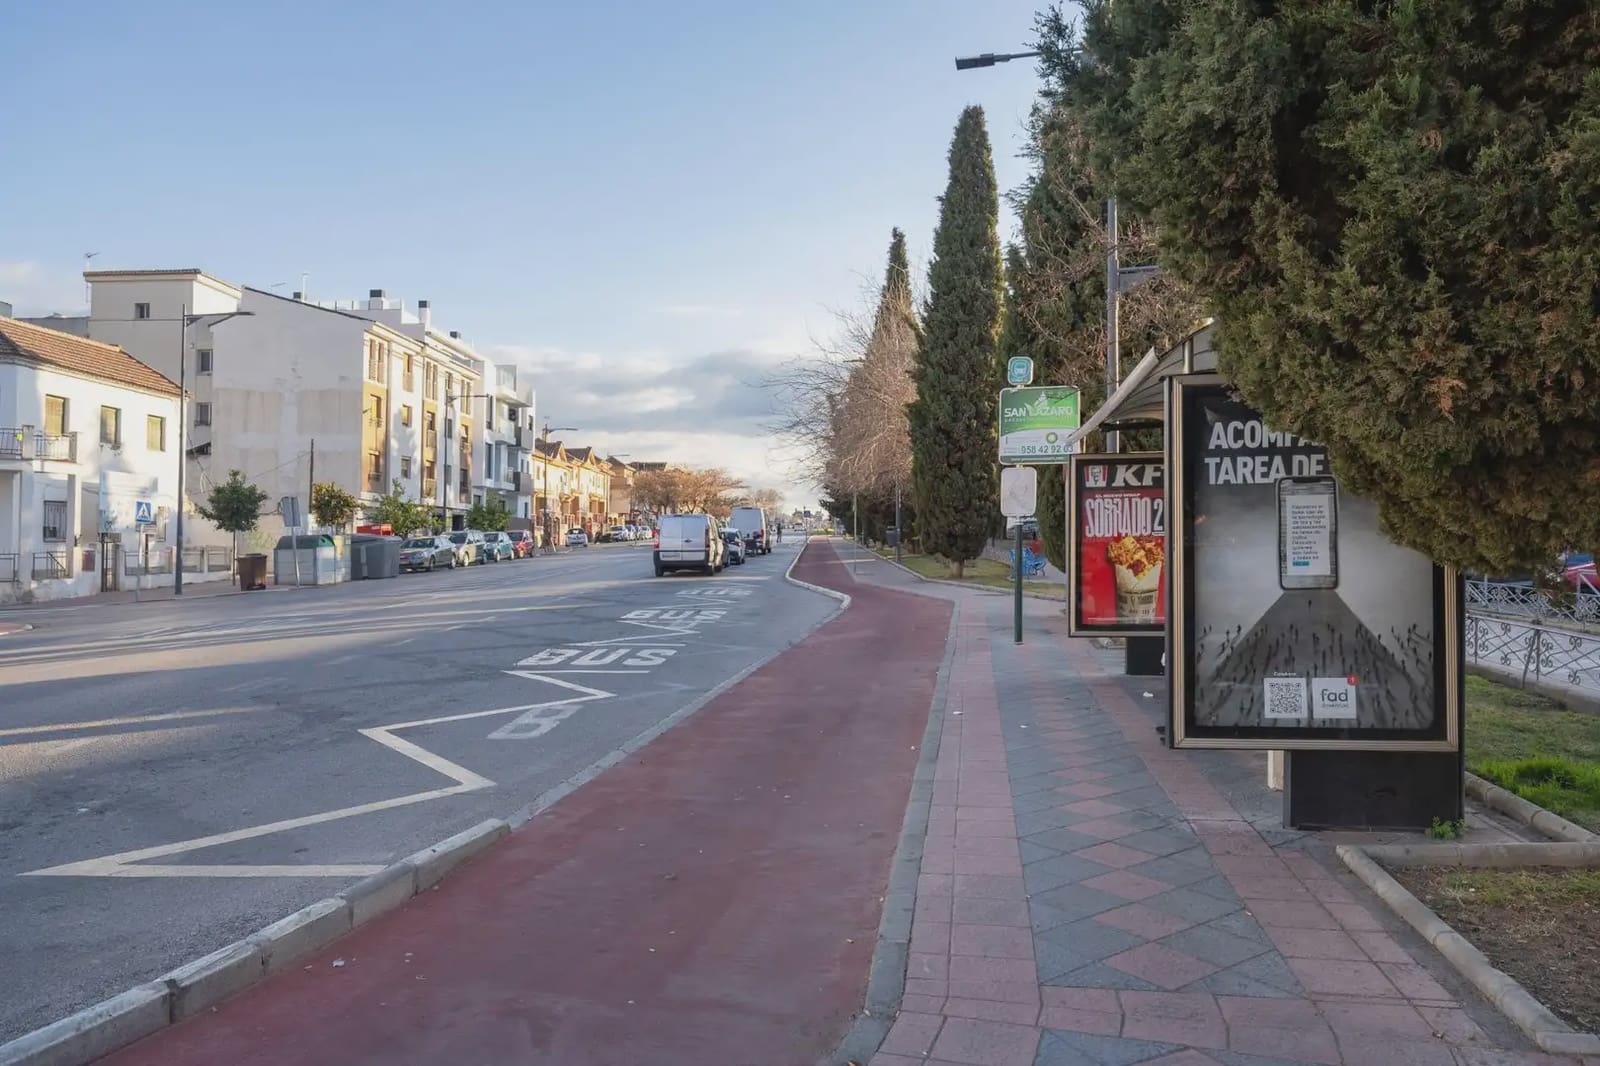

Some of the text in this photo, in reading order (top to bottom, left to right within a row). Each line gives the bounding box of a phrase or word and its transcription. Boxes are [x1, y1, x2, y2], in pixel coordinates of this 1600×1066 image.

[1004, 407, 1027, 418] SAN
[1208, 420, 1326, 449] ACOM
[1038, 445, 1049, 454] 42
[1051, 444, 1062, 454] 92
[1204, 455, 1287, 485] TAREA
[620, 609, 728, 620] BUS
[513, 648, 678, 666] BUS
[1320, 688, 1349, 702] fad
